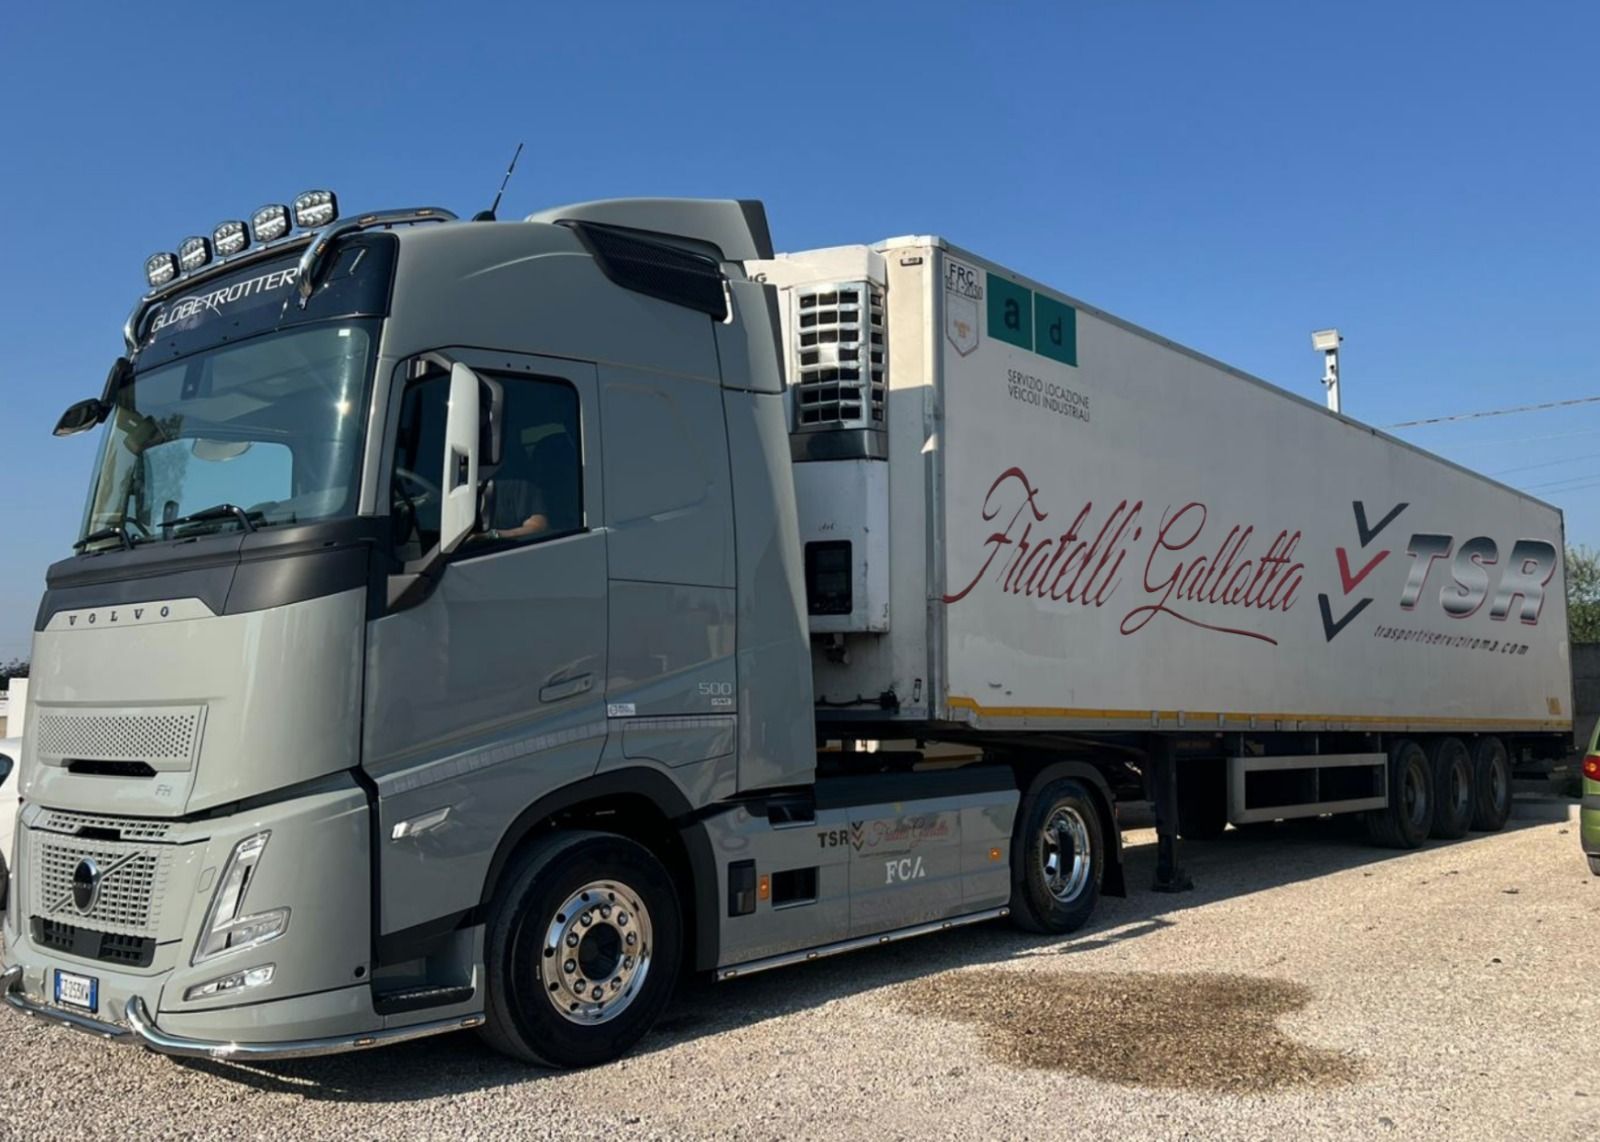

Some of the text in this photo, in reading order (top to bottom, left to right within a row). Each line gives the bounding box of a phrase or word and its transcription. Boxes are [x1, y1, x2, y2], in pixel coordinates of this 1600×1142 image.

[949, 263, 974, 287] FRC
[150, 267, 299, 334] GLOBETROTTER
[1007, 368, 1089, 409] SERVIZIO LOCAZIONE
[1007, 384, 1041, 406] VEICOLI
[943, 467, 1304, 646] Fratelli Gallotta
[1399, 533, 1558, 626] TSR
[69, 606, 170, 627] VOLVO
[698, 682, 732, 696] 500
[817, 830, 849, 849] TSR
